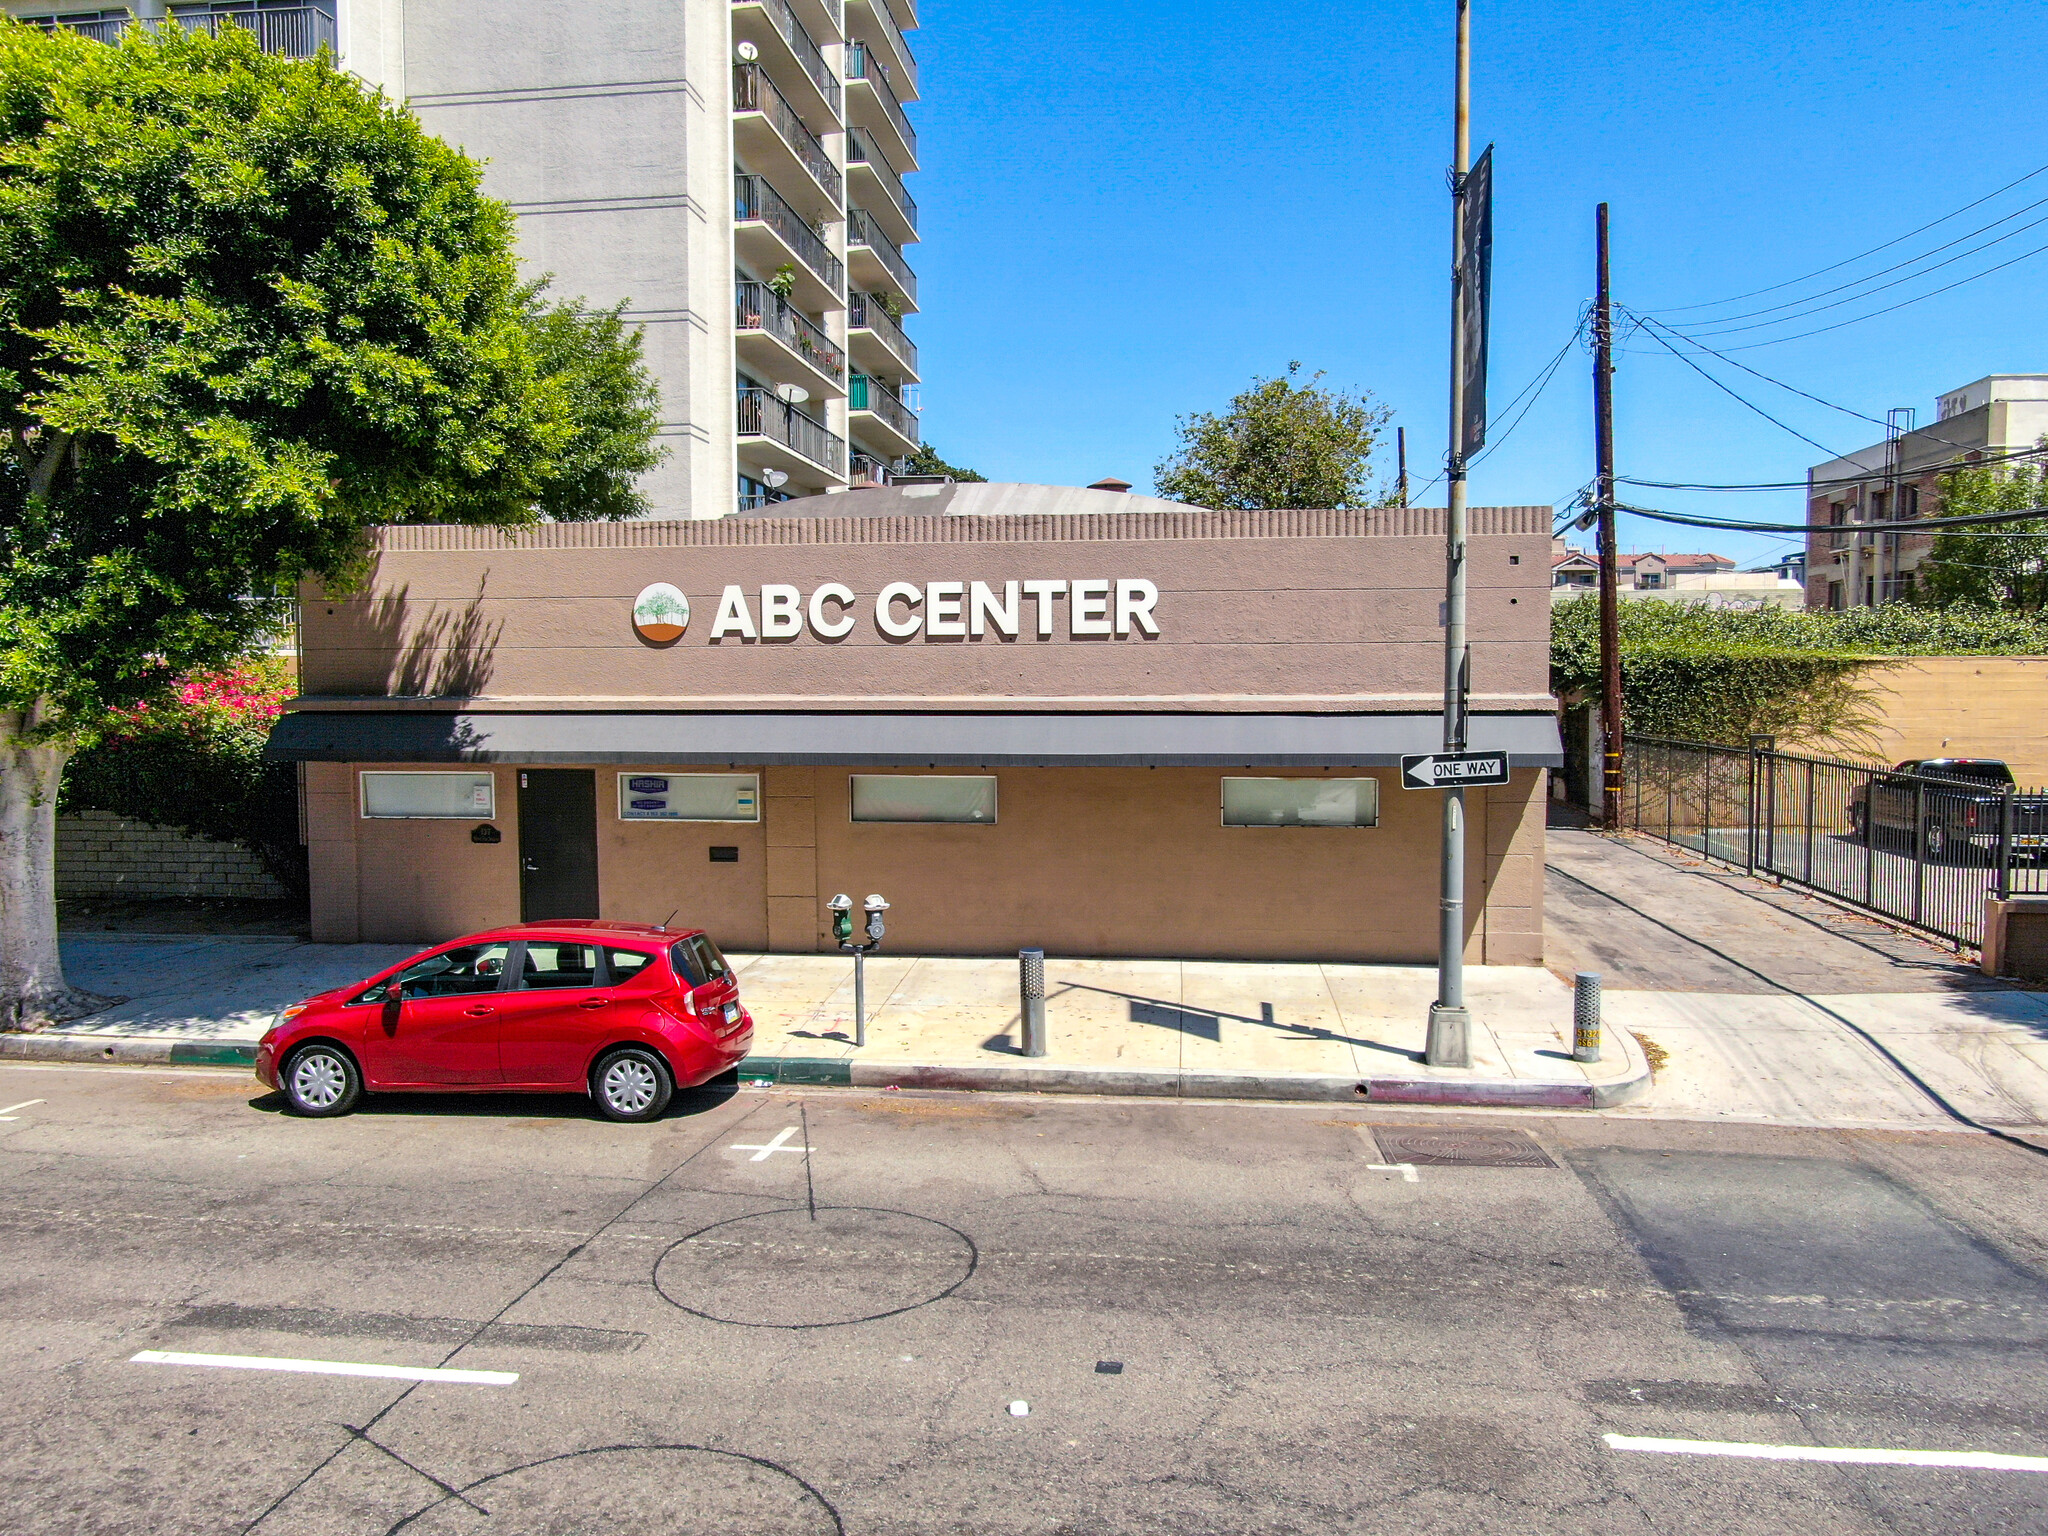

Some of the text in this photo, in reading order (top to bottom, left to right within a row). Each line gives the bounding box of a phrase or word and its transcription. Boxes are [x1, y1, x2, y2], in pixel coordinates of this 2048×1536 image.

[709, 578, 1160, 641] ABC CENTER
[1434, 762, 1496, 777] ONE WAY
